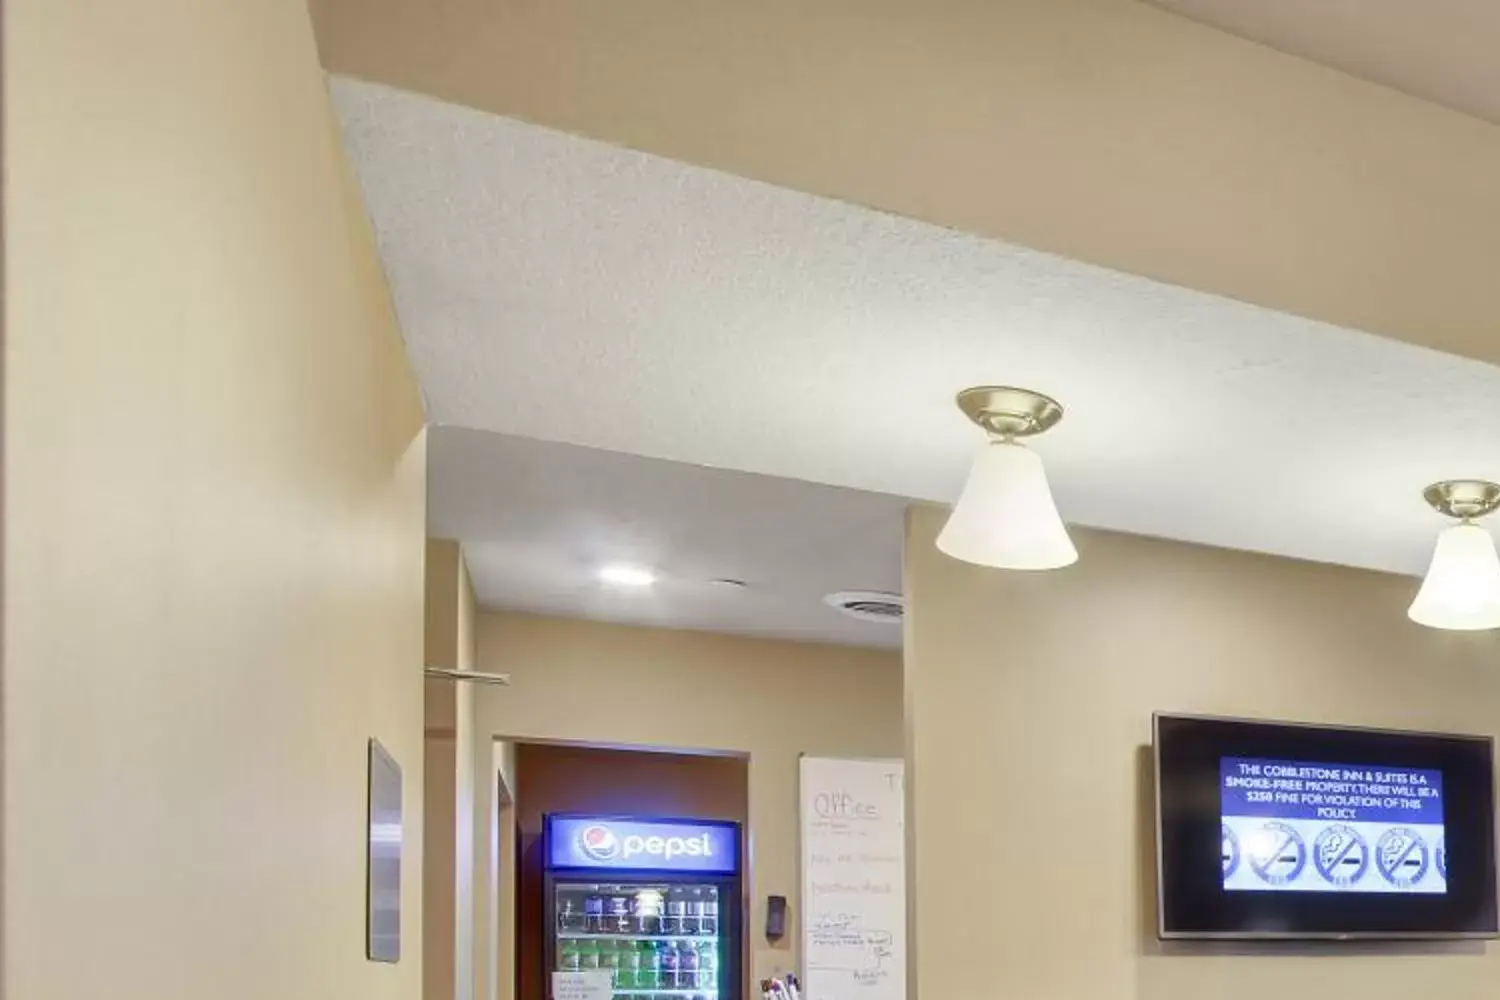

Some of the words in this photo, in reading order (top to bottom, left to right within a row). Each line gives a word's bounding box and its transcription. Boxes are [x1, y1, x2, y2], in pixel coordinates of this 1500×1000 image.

[1238, 764, 1261, 776] THE
[1342, 770, 1363, 781] INN
[1225, 776, 1303, 790] SMOKE-FREE
[1392, 785, 1416, 797] WILL
[1276, 792, 1299, 804] FINE
[1302, 793, 1323, 805] FOR
[1324, 794, 1382, 808] VIOLATION
[1383, 797, 1398, 809] OF
[622, 833, 713, 860] pepsi
